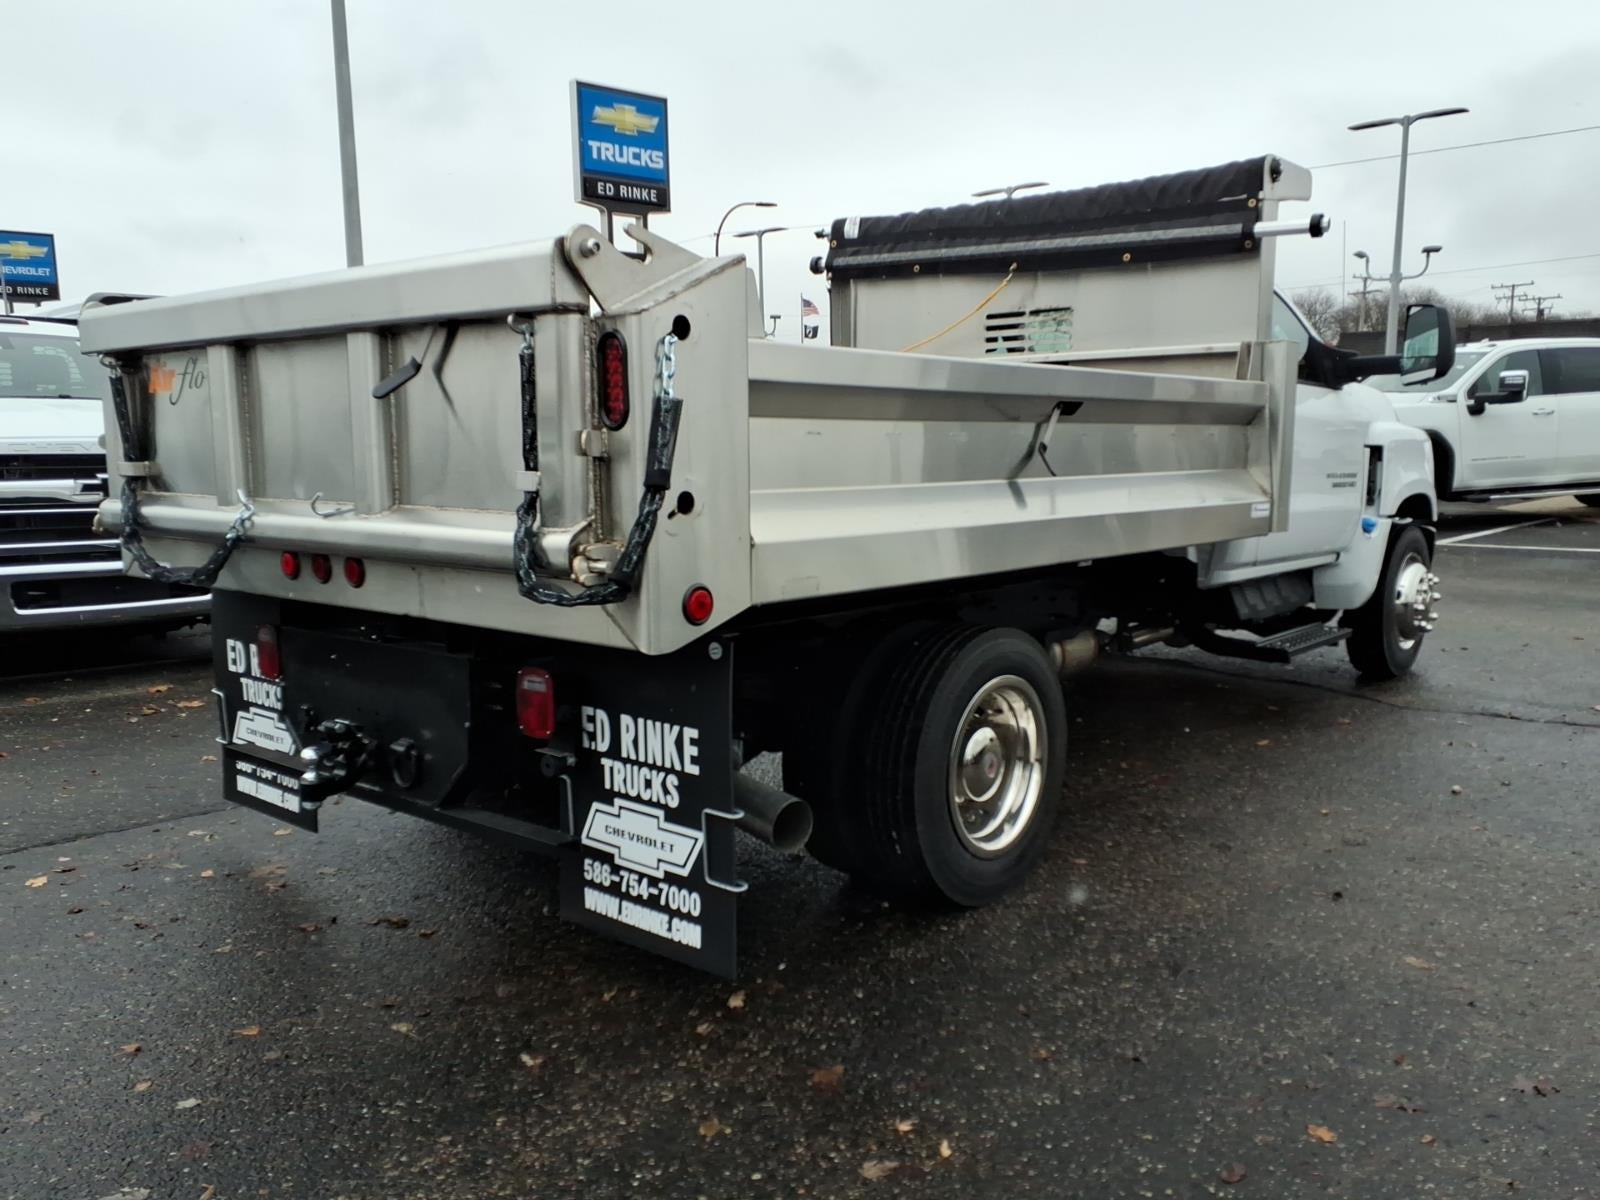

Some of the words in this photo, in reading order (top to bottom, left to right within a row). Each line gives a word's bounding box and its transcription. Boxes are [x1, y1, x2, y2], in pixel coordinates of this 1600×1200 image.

[588, 139, 664, 169] TRUCKS
[597, 181, 614, 196] ED
[619, 184, 657, 202] RINKE
[0, 265, 51, 276] HEVROLET
[17, 286, 49, 296] RINKE
[226, 638, 247, 673] ED
[619, 713, 701, 776] RINKE
[600, 757, 680, 808] TRUCKS
[604, 824, 675, 853] CHEVROLET
[583, 858, 701, 917] 586-754-7000
